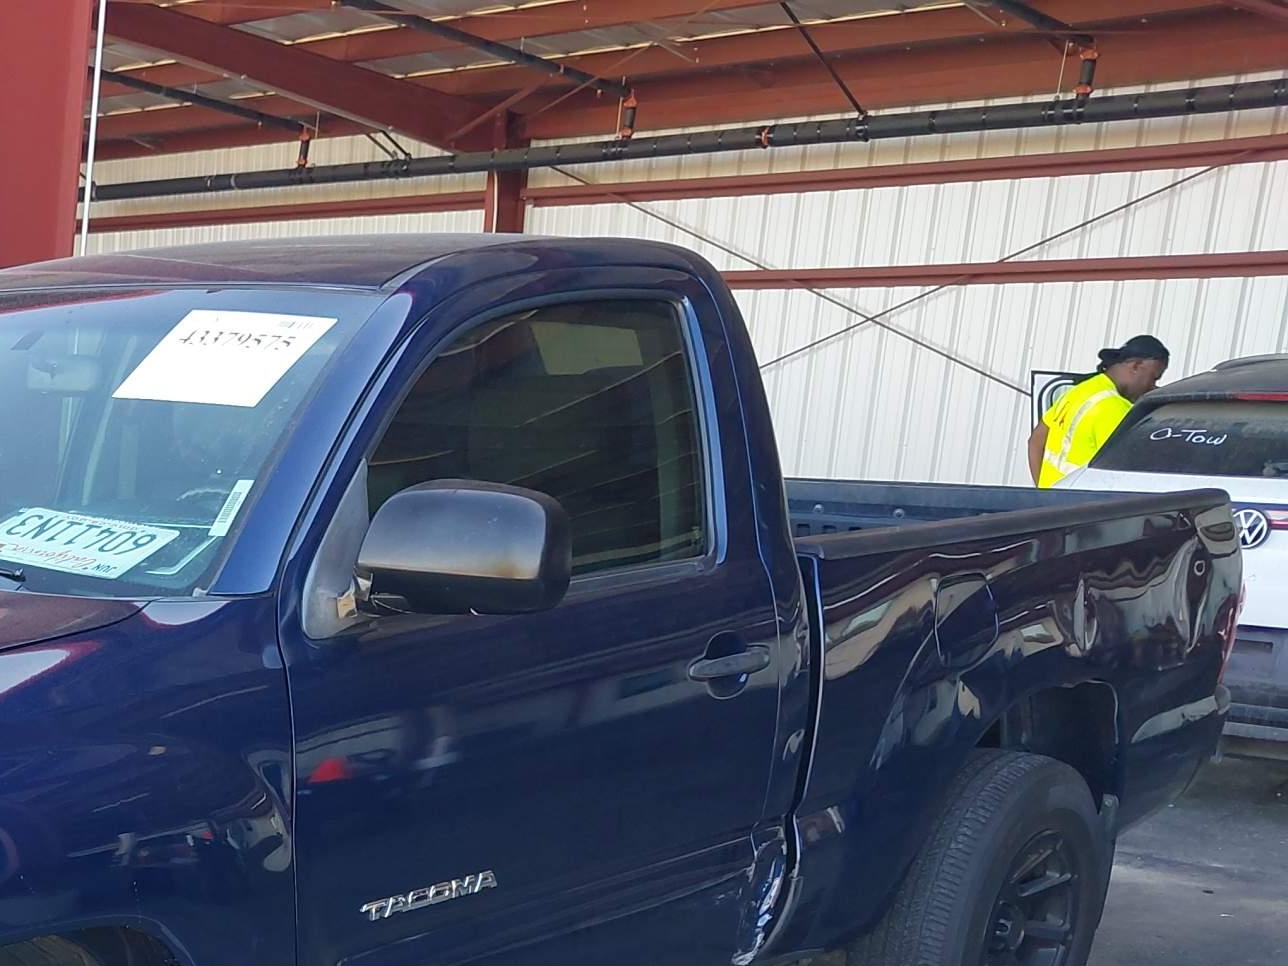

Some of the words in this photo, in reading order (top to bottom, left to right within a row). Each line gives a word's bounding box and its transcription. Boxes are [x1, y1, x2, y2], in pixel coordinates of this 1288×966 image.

[179, 329, 297, 351] 43379575
[5, 514, 158, 556] 60411N3
[11, 542, 98, 569] California
[92, 562, 117, 574] JUN
[359, 869, 499, 921] TACOMA
